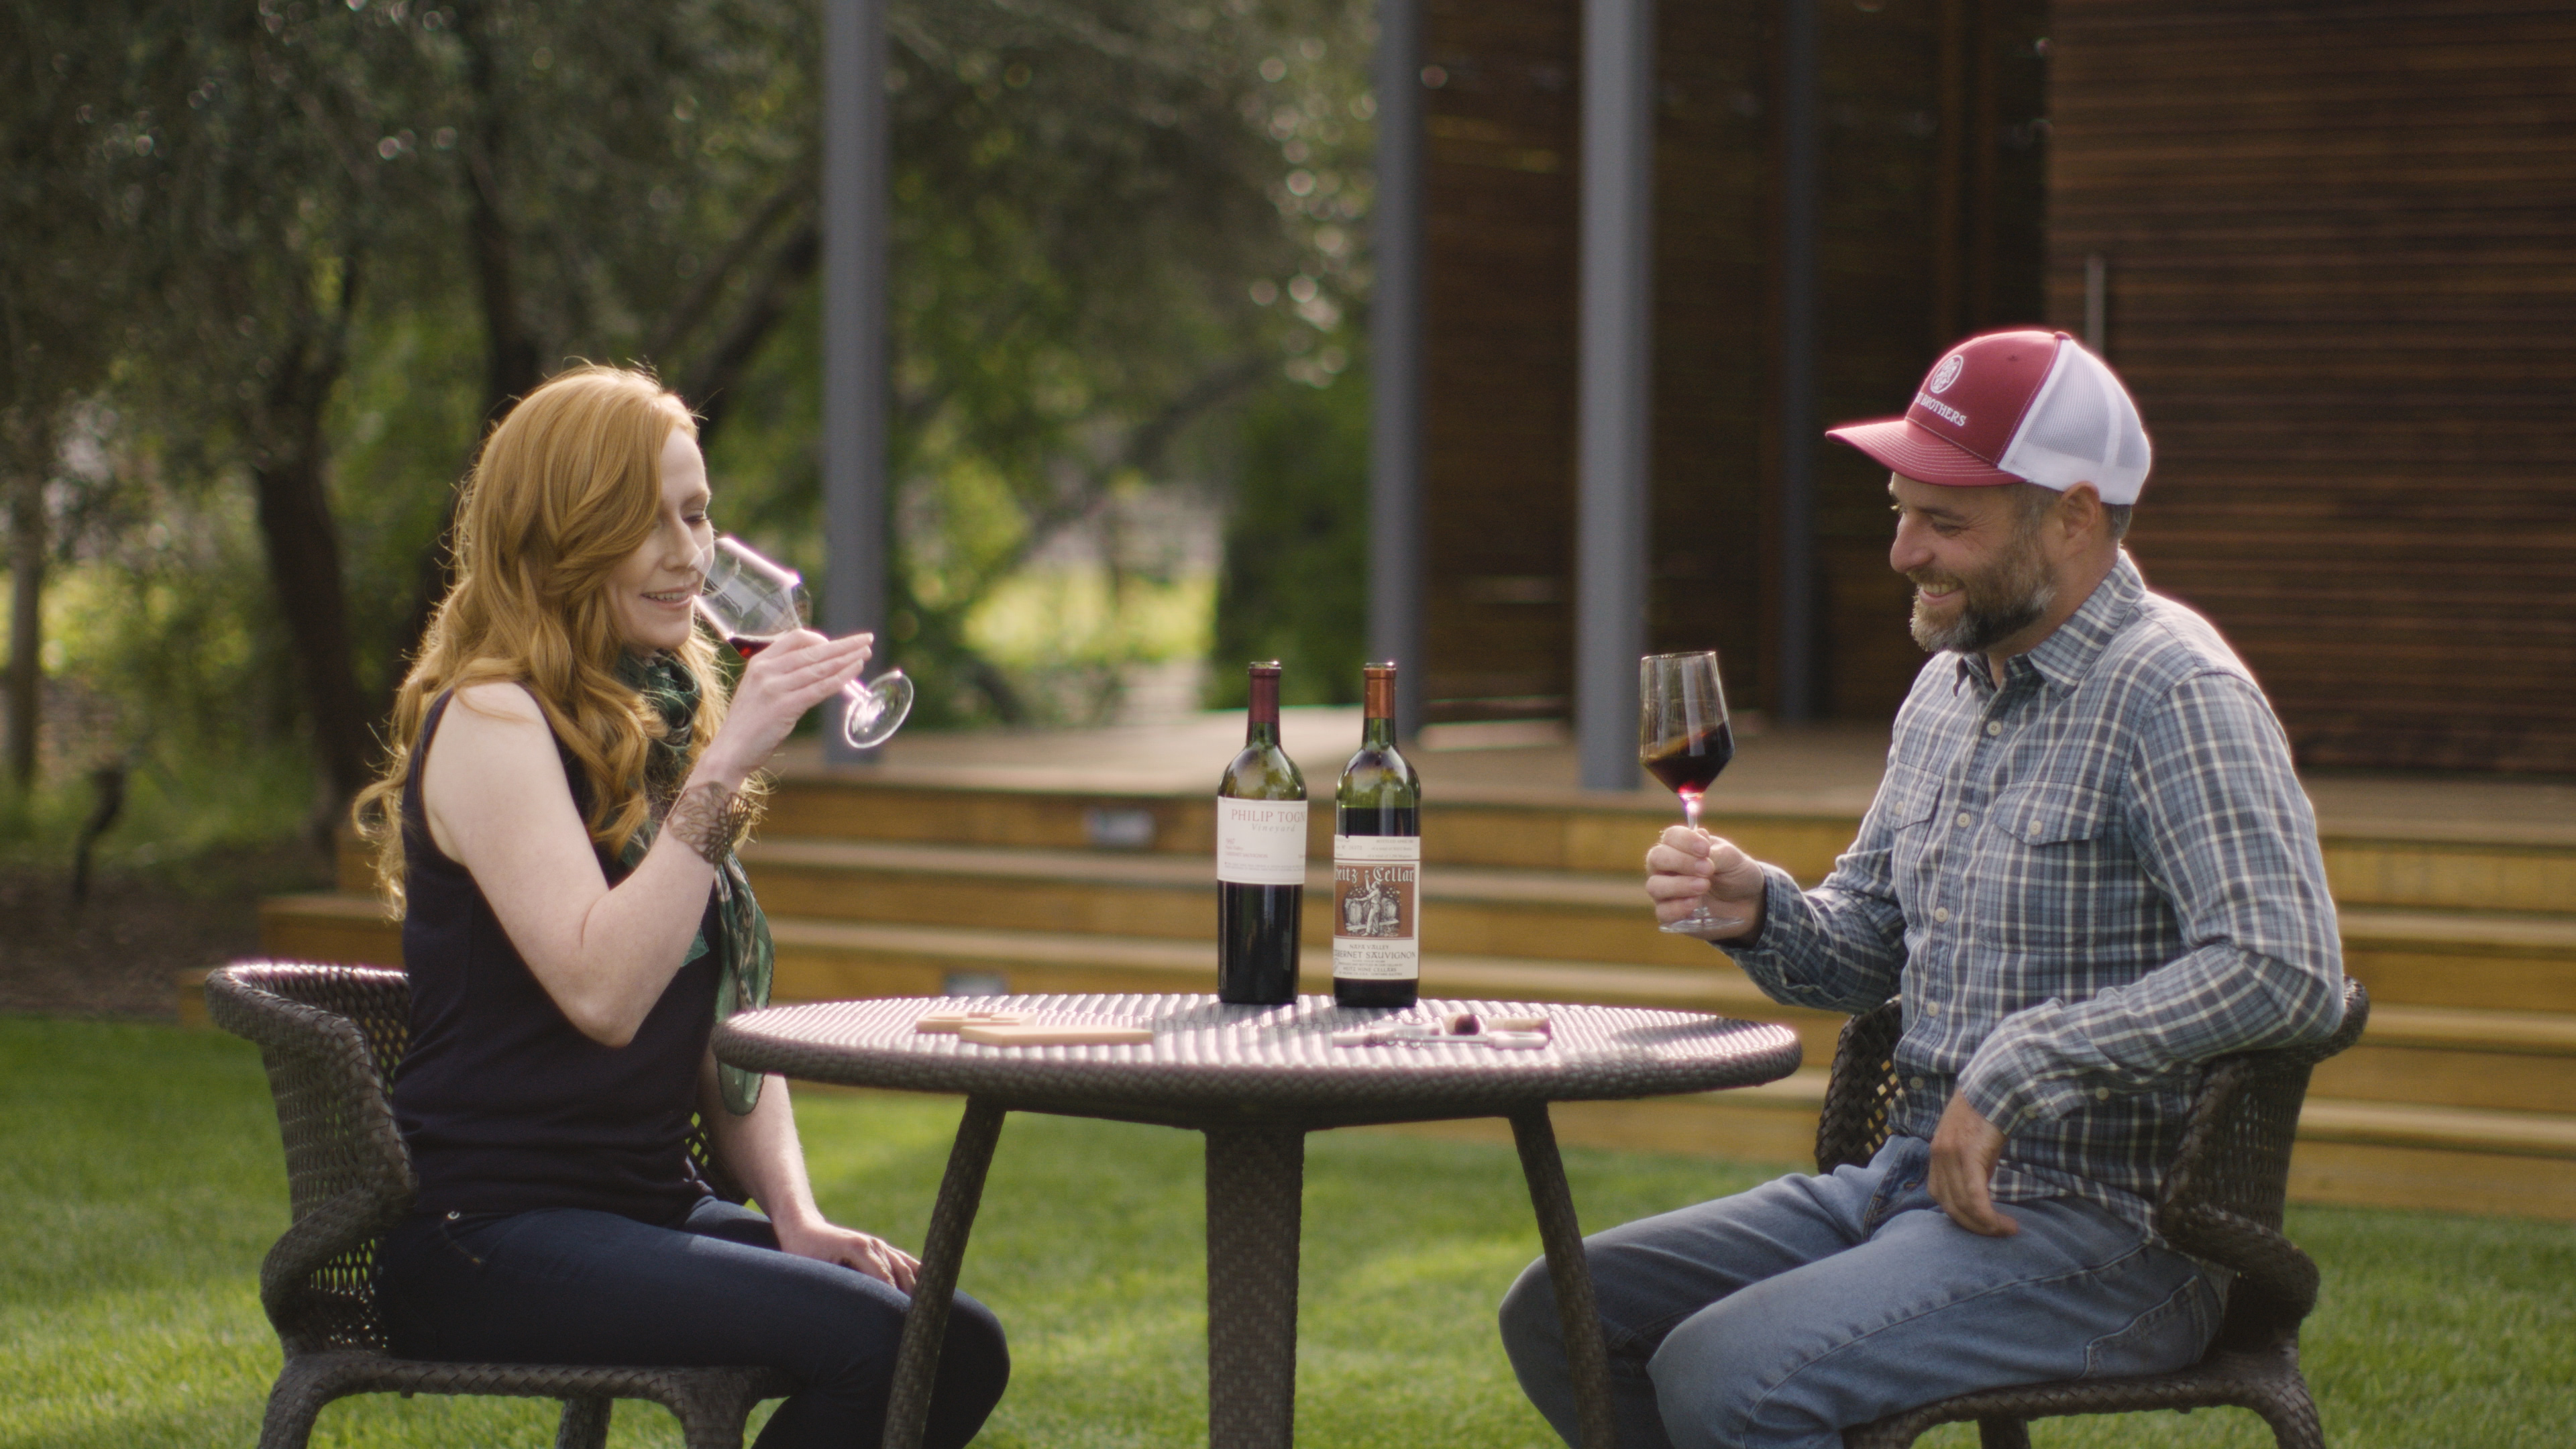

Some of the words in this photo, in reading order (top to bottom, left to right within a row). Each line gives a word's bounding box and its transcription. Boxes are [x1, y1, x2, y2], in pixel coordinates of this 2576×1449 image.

[1920, 394, 1968, 427] BROTHERS
[1230, 809, 1273, 822] PHILIP
[1277, 810, 1306, 822] TOGN
[1251, 822, 1296, 833] Vineyard
[1373, 865, 1415, 883] Cellar
[1334, 949, 1362, 959] ABERNET
[1366, 951, 1415, 959] SAUVIGNON
